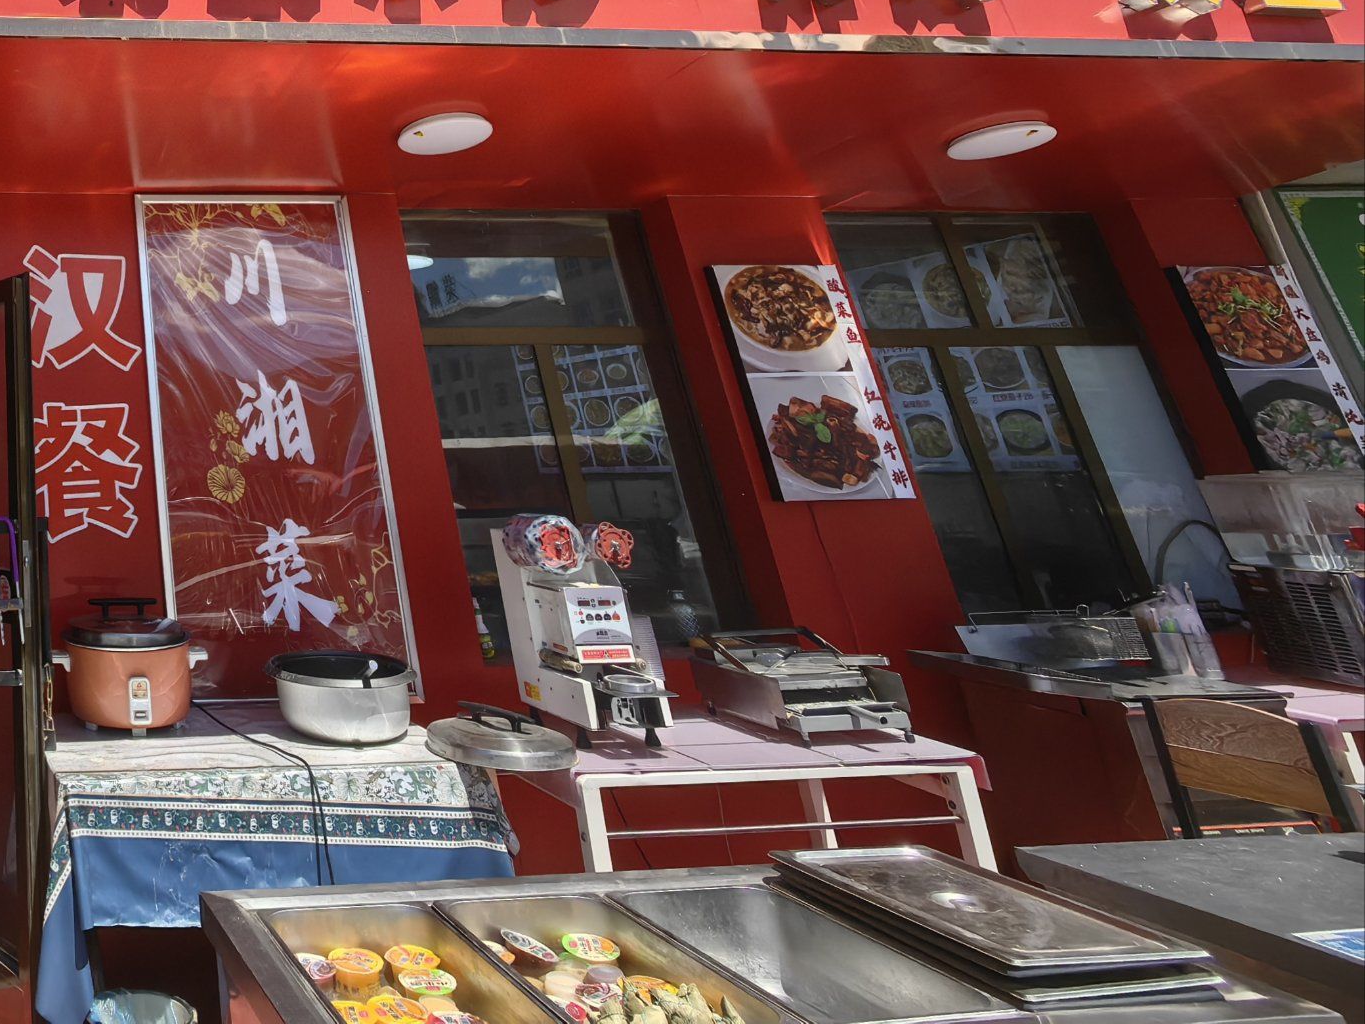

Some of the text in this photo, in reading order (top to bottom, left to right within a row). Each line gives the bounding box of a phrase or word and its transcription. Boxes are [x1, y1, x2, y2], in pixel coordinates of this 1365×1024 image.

[22, 243, 143, 544] 汉餐
[826, 277, 863, 345] 酸菜鱼
[224, 238, 339, 633] 川湘菜
[863, 386, 910, 490] 红烧牛排
